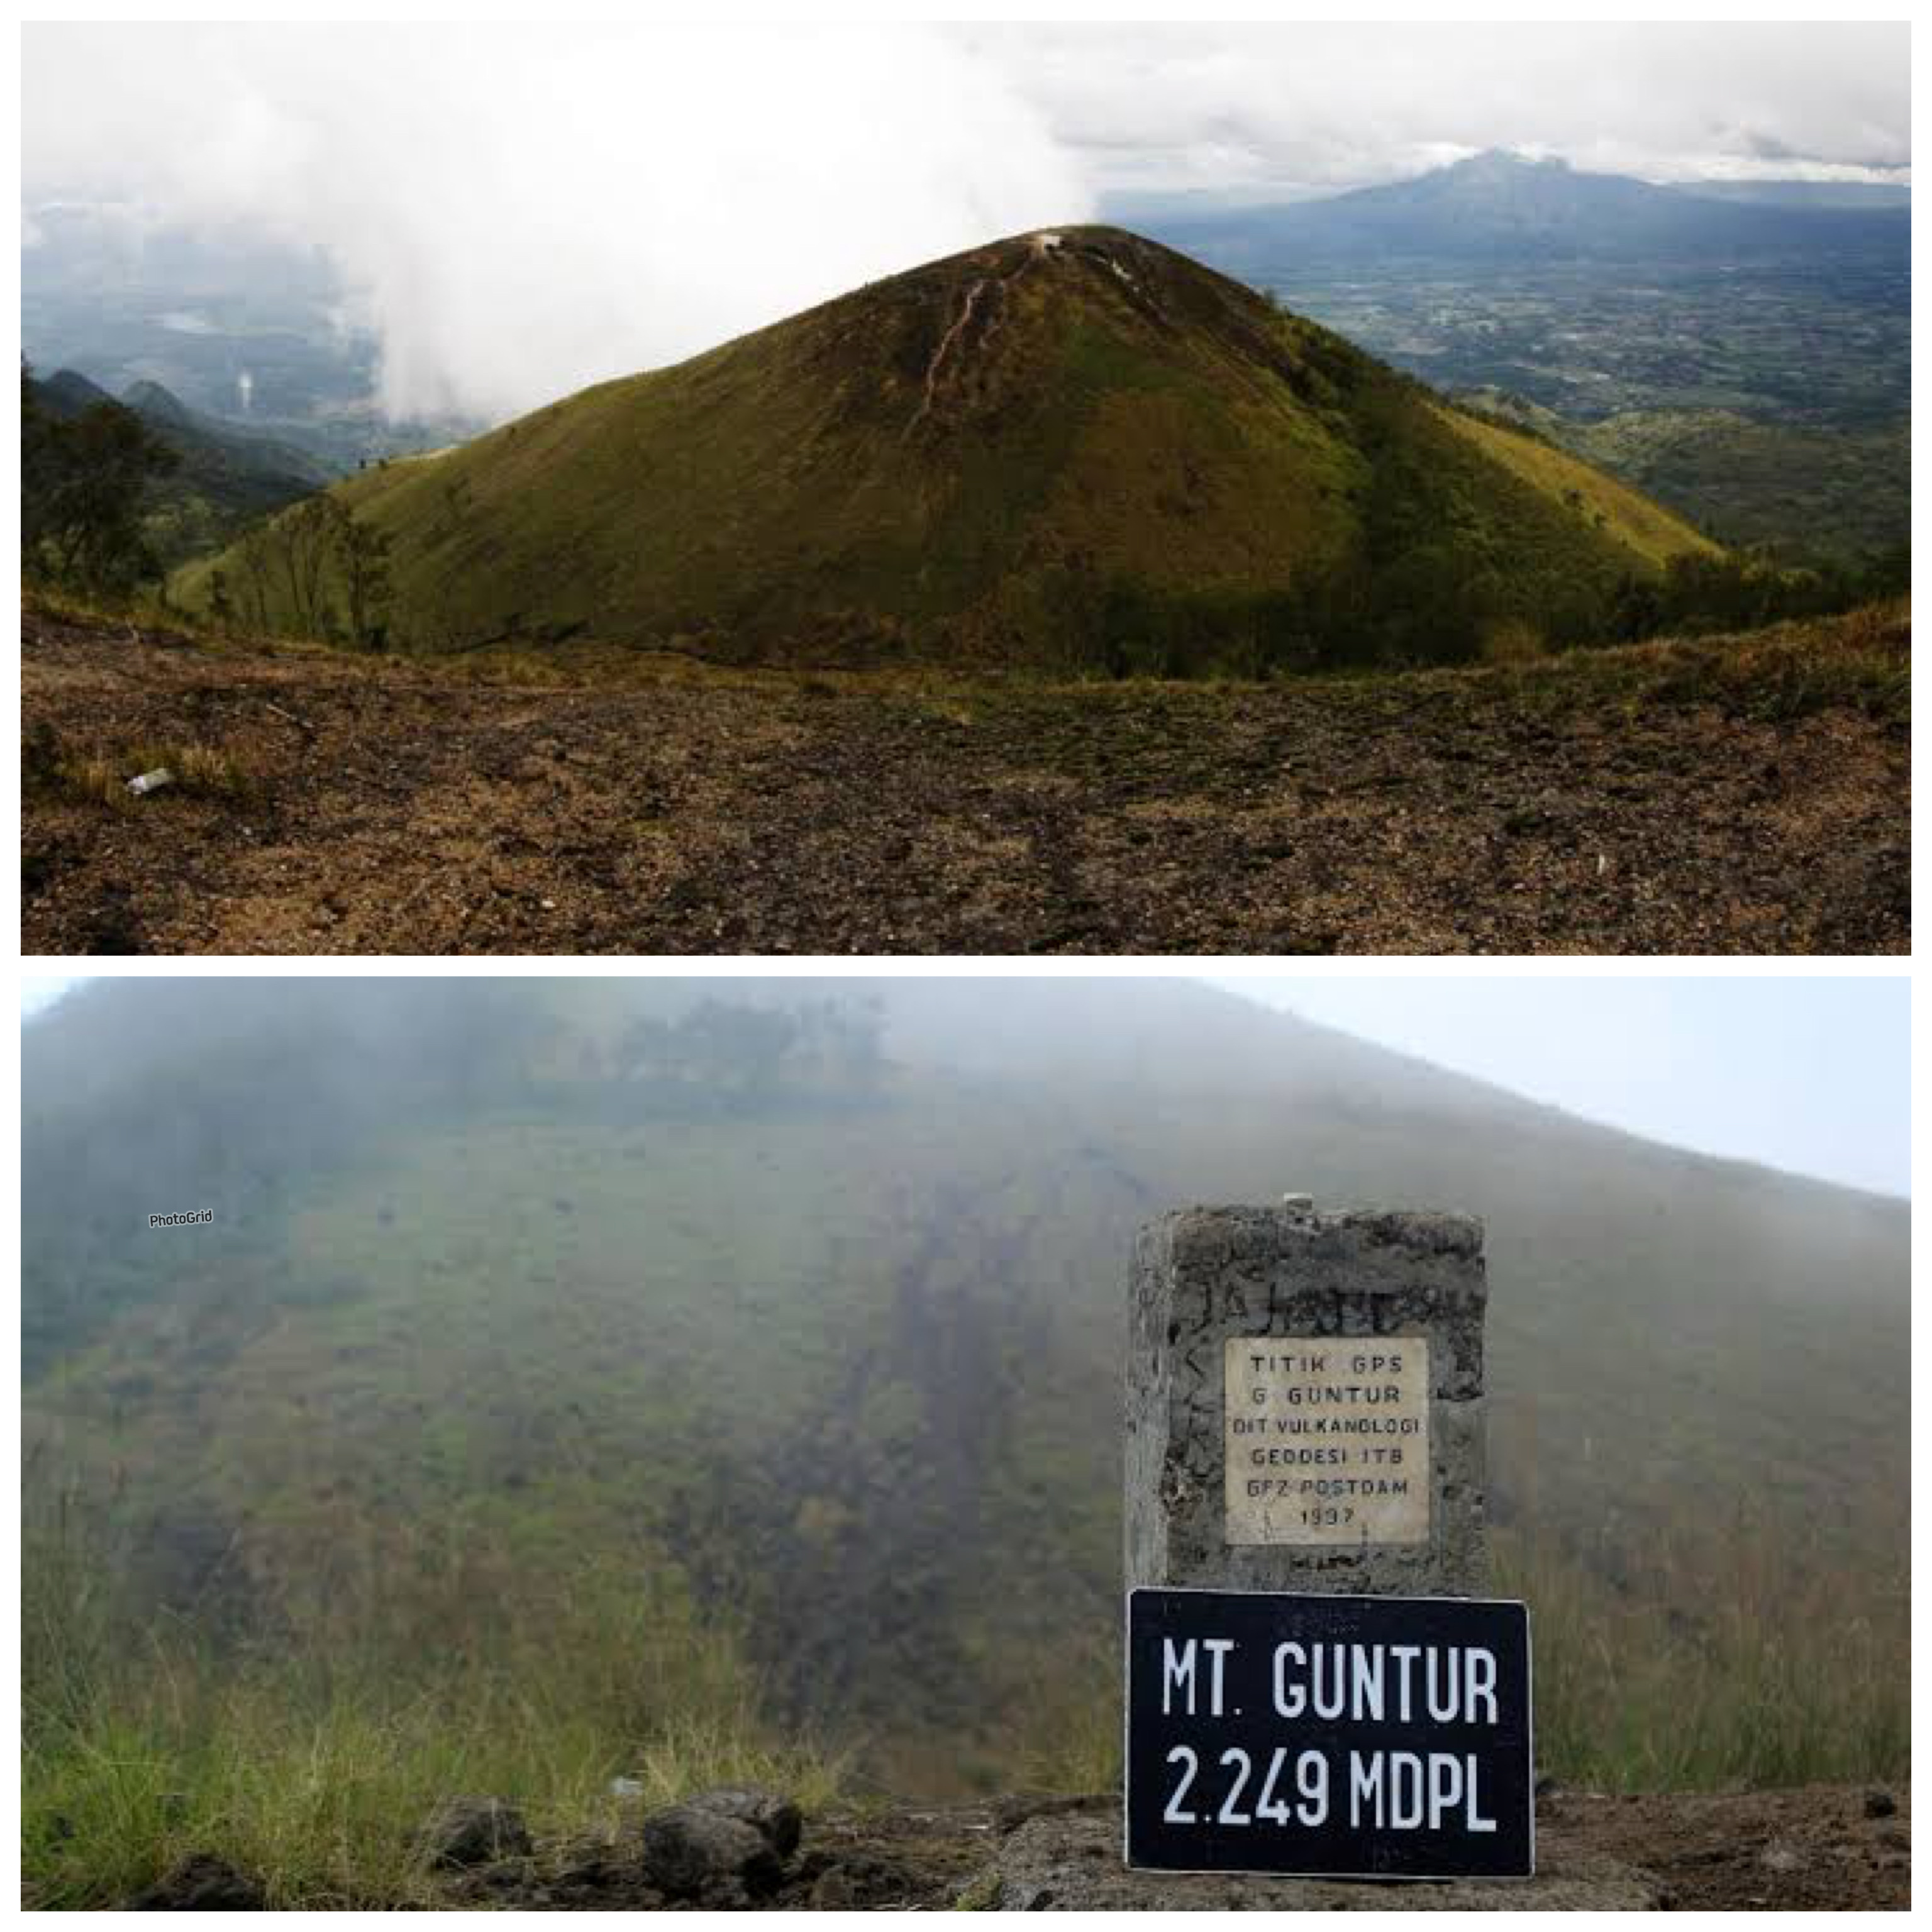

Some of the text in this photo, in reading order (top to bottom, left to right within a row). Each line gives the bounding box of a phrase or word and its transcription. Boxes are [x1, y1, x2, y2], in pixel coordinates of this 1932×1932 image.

[1250, 1356, 1402, 1374] TITIK GPS
[1253, 1386, 1400, 1405] G GUNTUR
[1277, 1418, 1419, 1434] VULKANOLOGI
[1252, 1448, 1402, 1465] GEODESI ITB
[1247, 1480, 1407, 1497] GFZ POSTDAM
[1163, 1638, 1498, 1724] MT. GUNTUR
[1163, 1745, 1497, 1832] 2.249 MDPL
